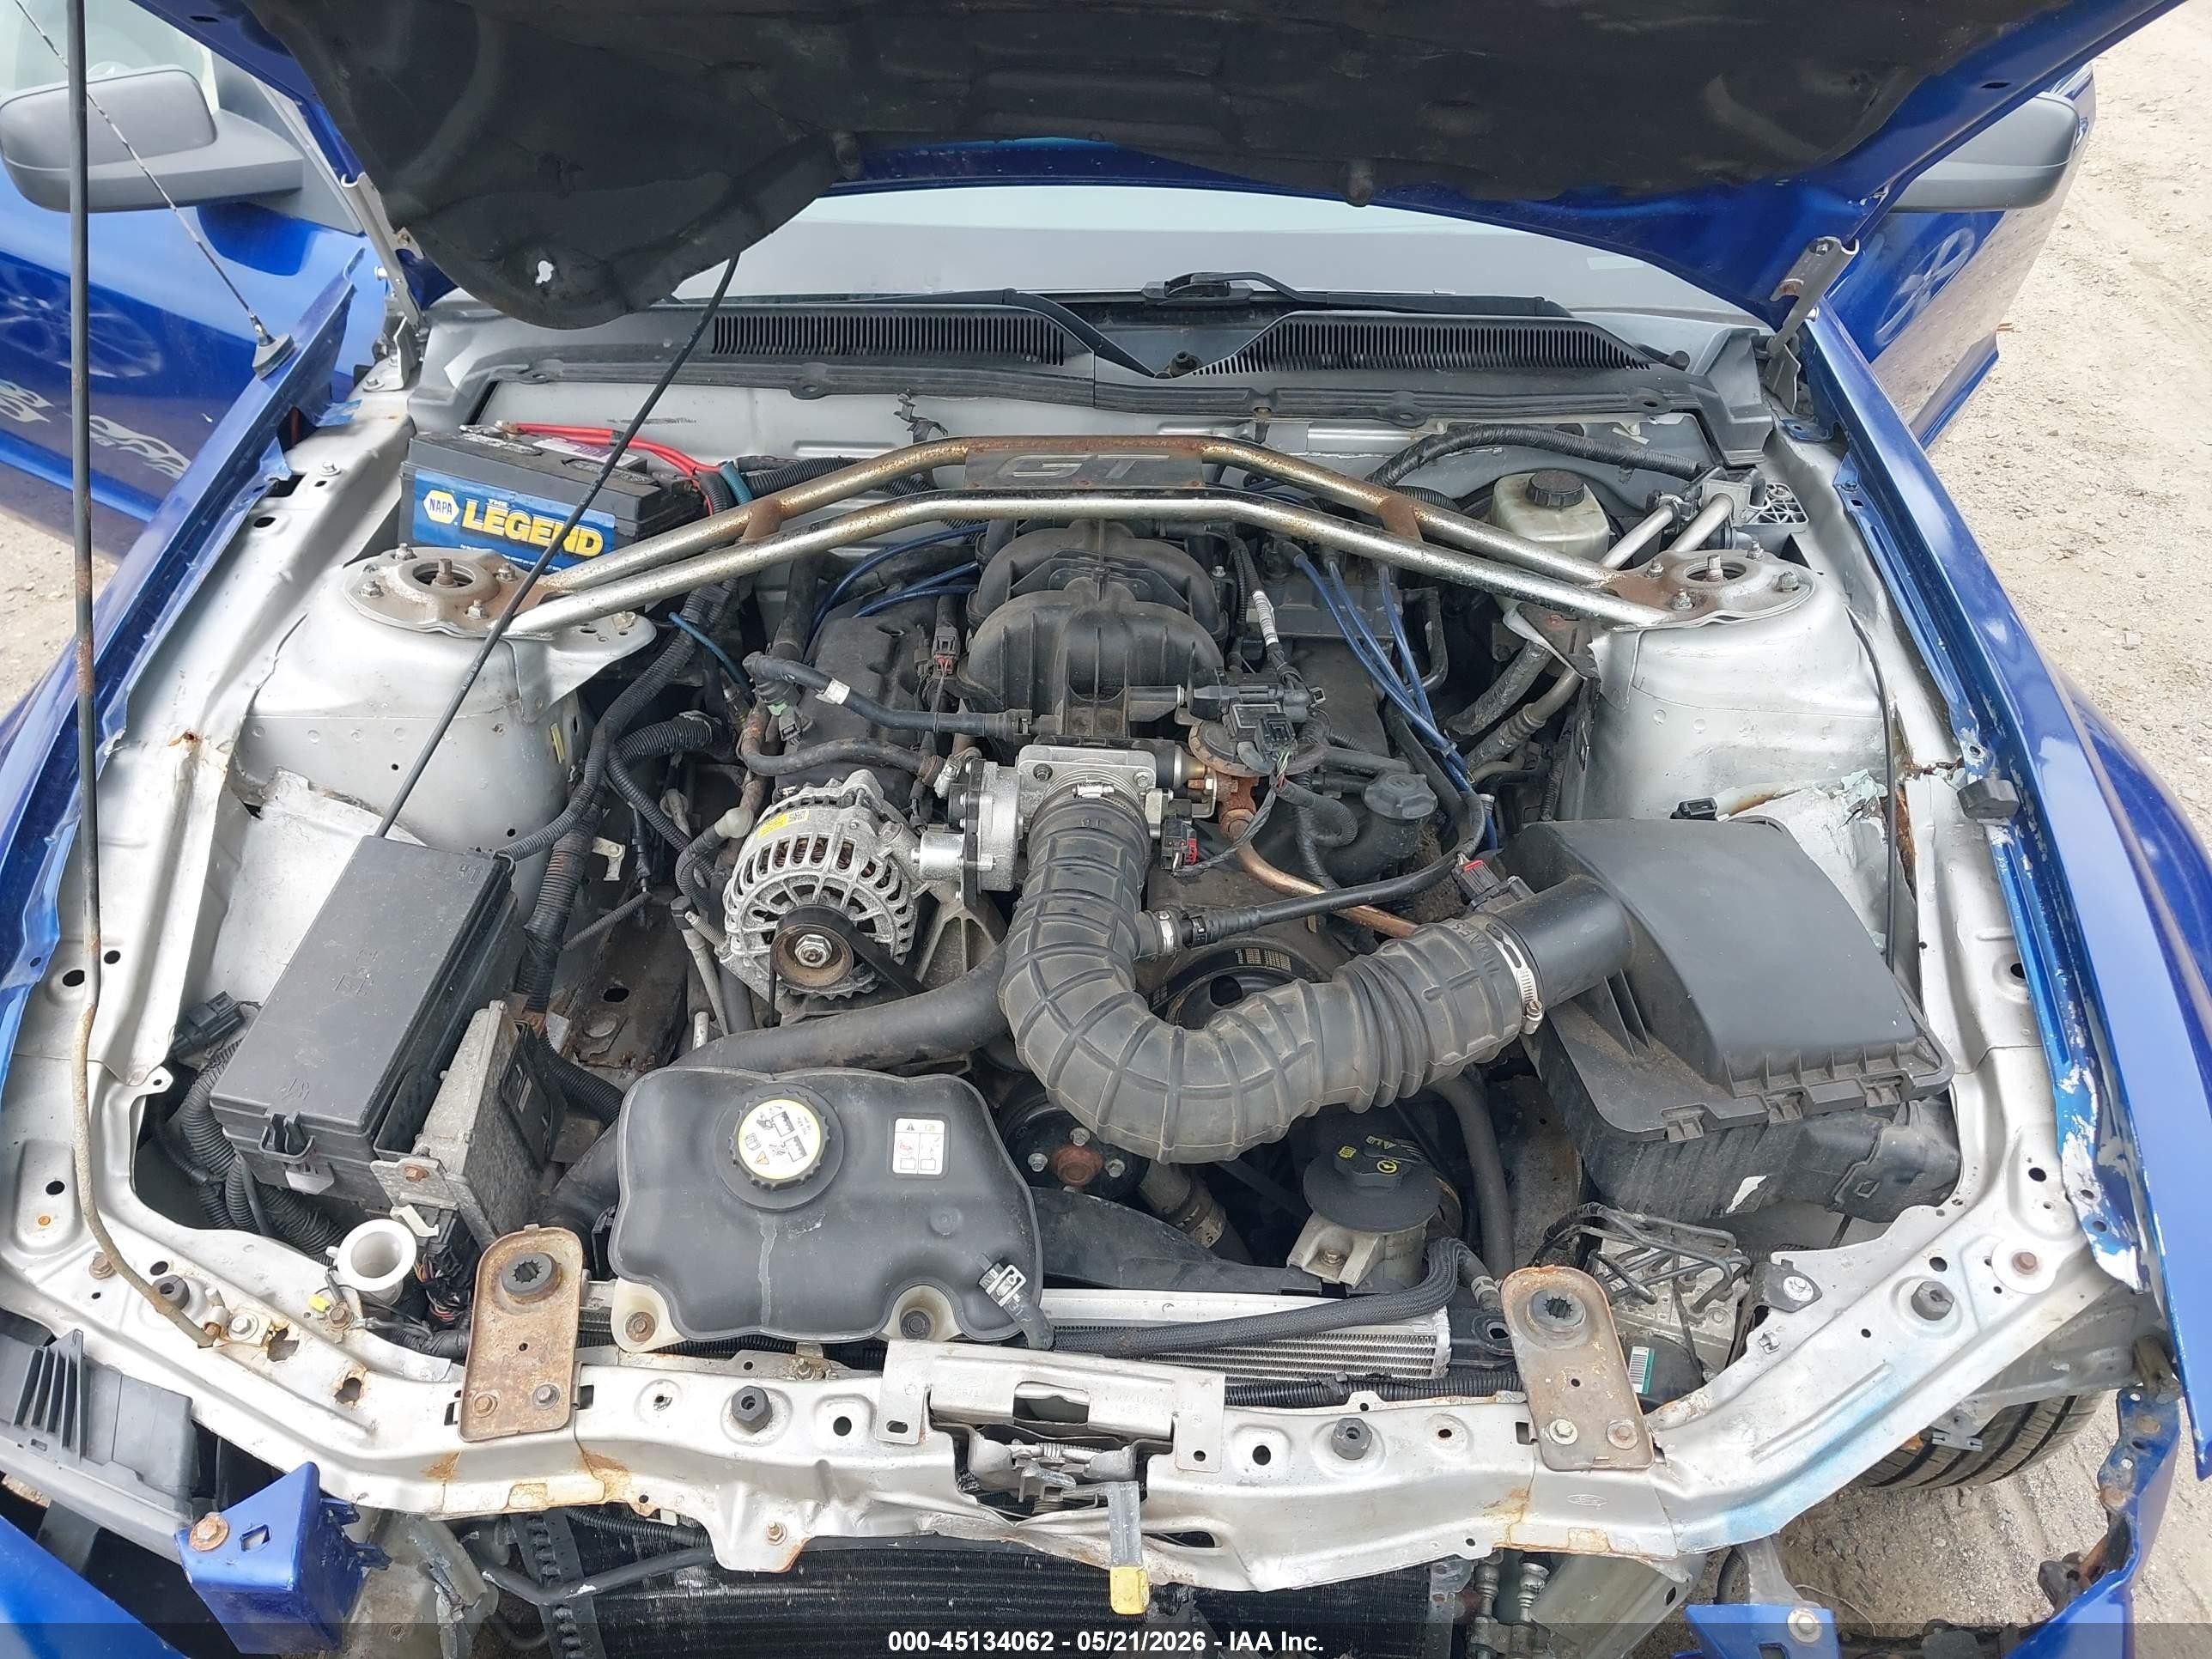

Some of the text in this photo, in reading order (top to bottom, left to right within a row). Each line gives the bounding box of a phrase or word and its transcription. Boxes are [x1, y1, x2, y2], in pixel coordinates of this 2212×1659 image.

[996, 453, 1170, 479] GT
[428, 497, 453, 516] NAPA
[487, 498, 509, 508] THE
[461, 498, 605, 557] LEGEND
